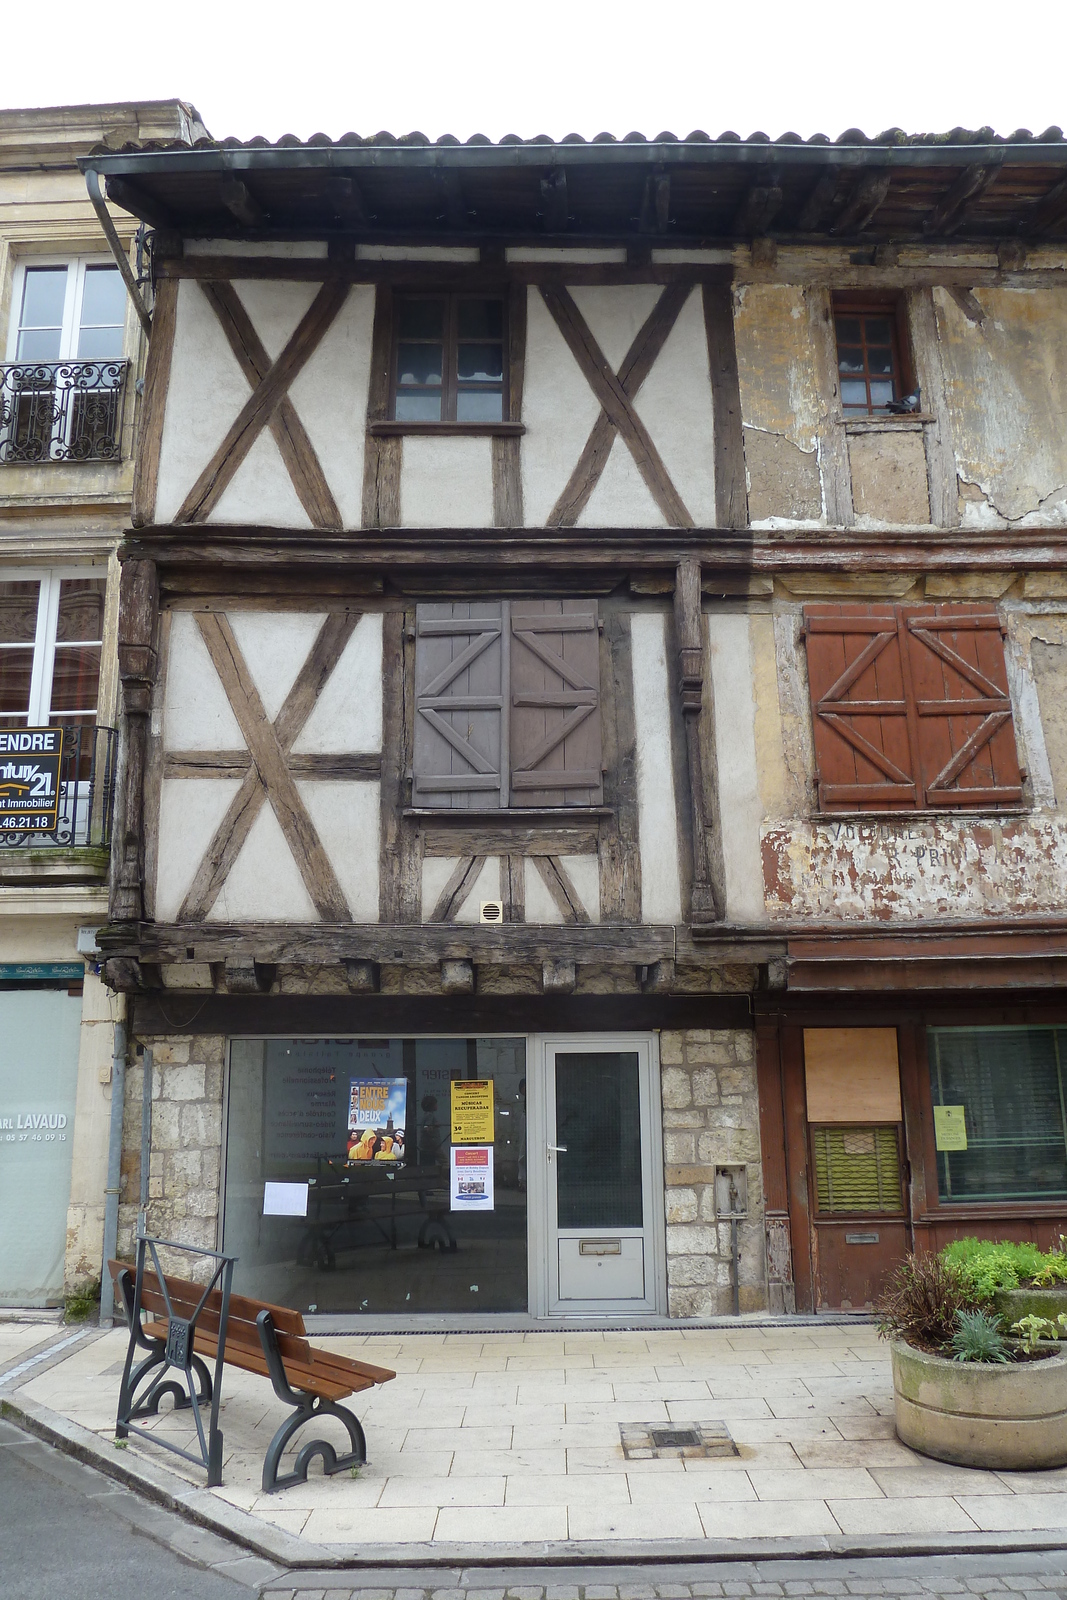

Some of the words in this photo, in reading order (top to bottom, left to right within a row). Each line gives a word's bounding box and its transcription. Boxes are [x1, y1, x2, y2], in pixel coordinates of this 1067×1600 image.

[8, 798, 54, 808] Immobilier
[360, 1086, 389, 1099] ENTRE
[359, 1098, 386, 1111] NOUS
[17, 1113, 68, 1130] LAVAUD
[359, 1110, 381, 1122] DEUX
